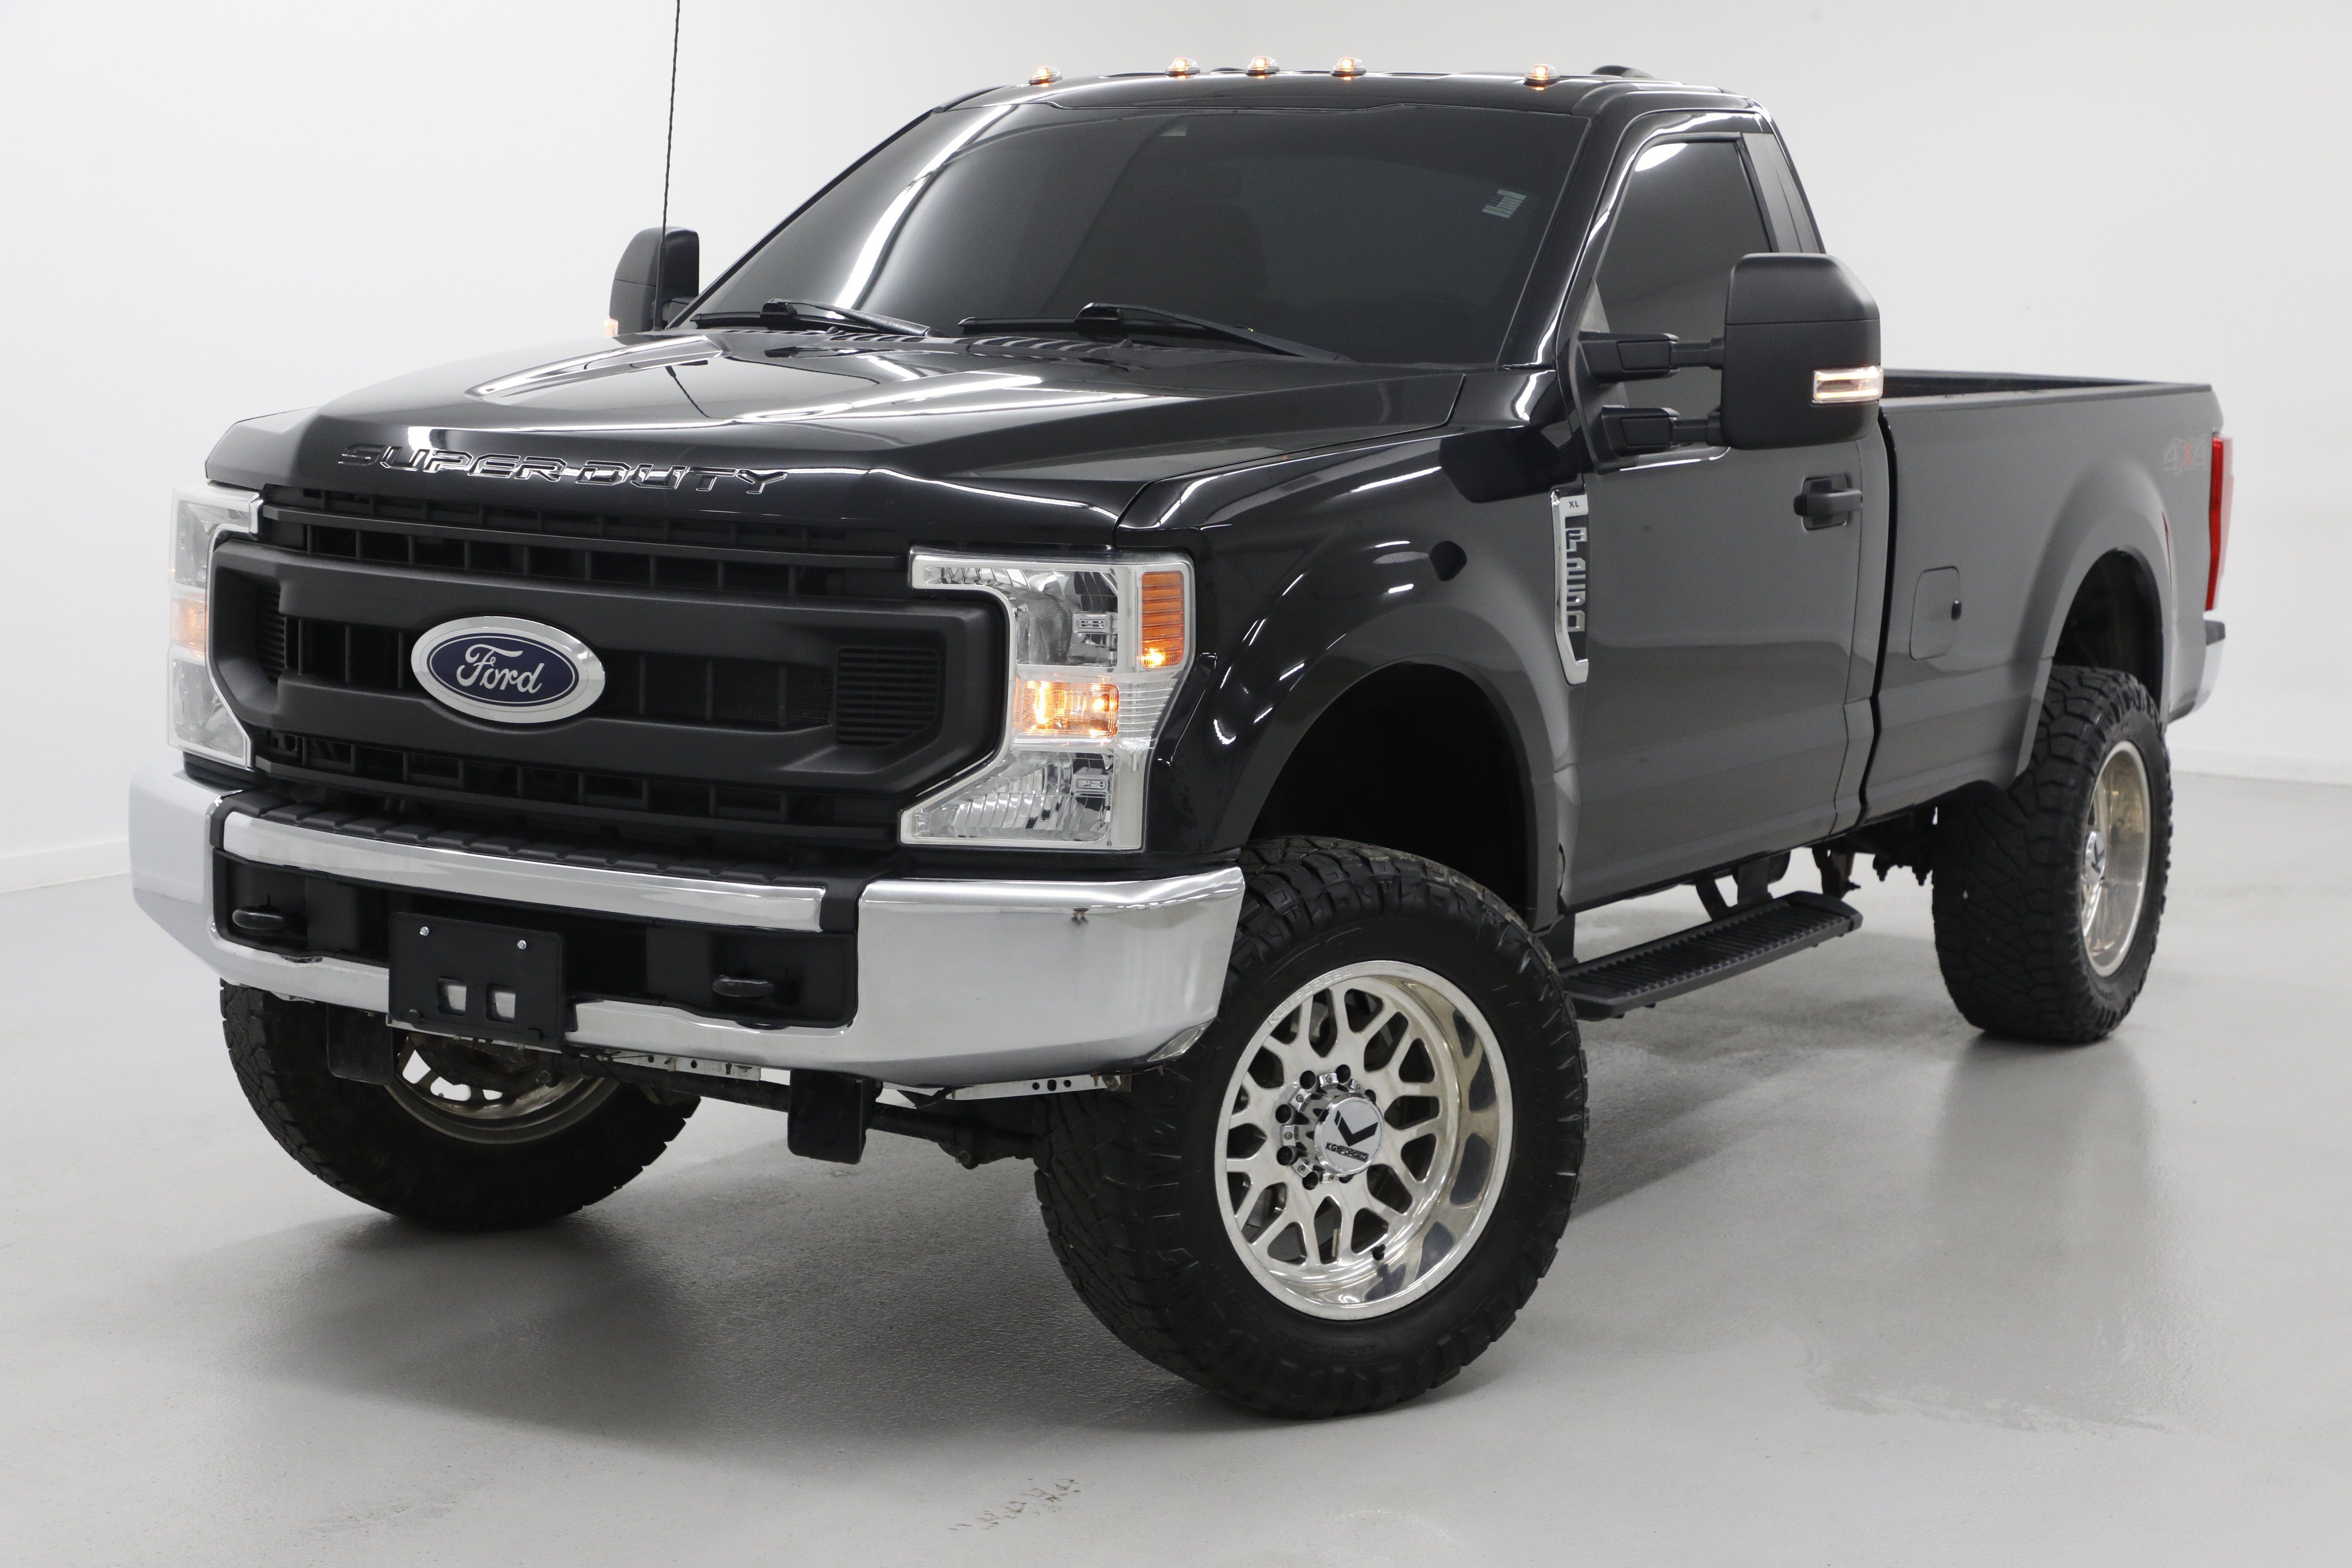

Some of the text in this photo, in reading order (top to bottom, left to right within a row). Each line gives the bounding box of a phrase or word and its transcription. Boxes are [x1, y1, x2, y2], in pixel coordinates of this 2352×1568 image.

[338, 444, 788, 494] SUPER DUTY
[1569, 500, 1580, 508] XL
[456, 644, 545, 694] Ford
[1340, 1146, 1368, 1162] FORGED
